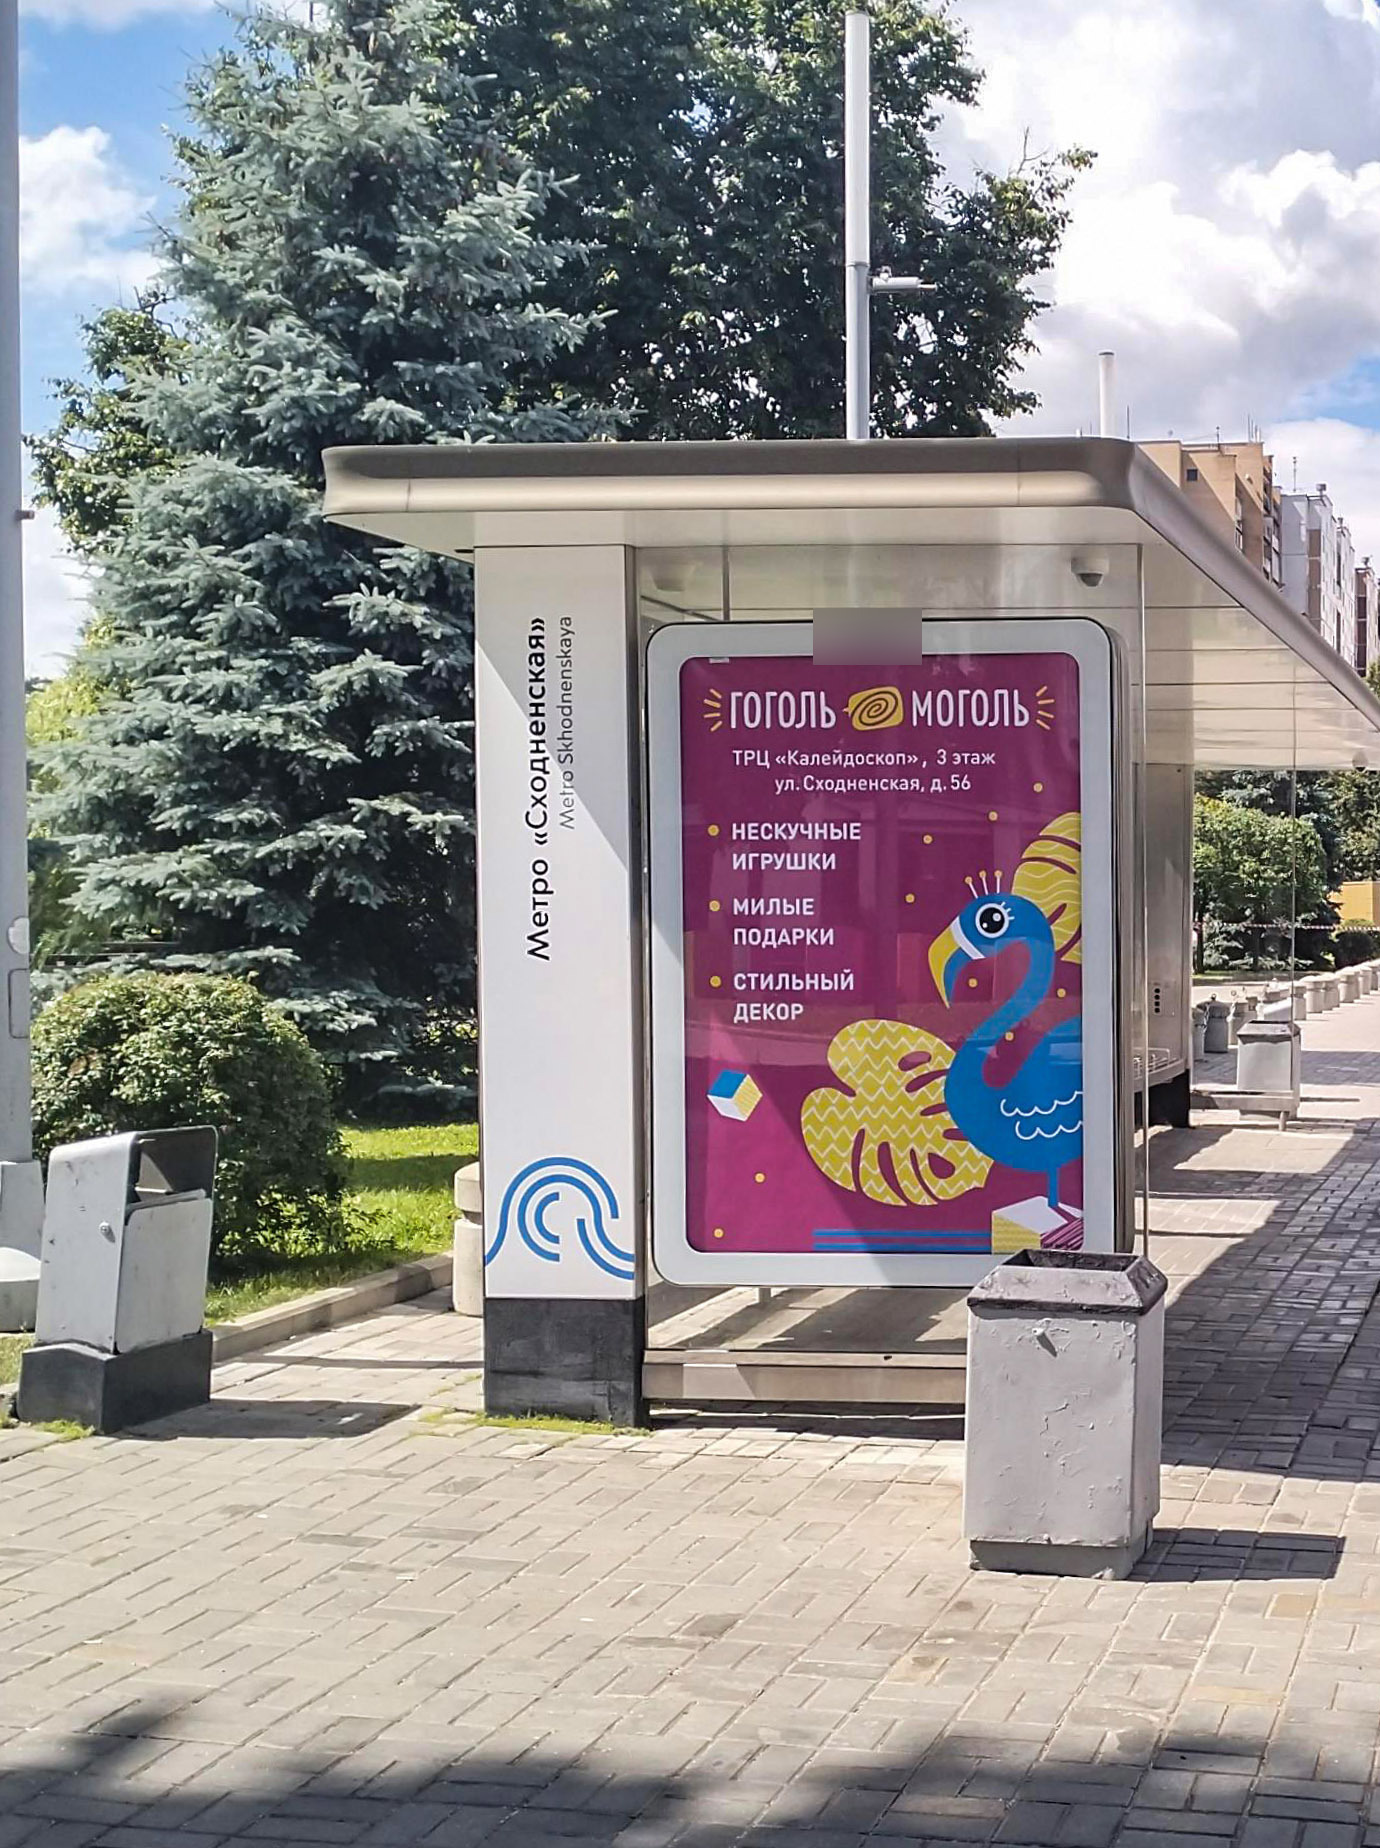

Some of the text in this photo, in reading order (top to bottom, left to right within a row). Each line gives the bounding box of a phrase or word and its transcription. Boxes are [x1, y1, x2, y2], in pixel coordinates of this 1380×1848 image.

[730, 688, 1031, 729] ГОГОЛЬ МОГОЛЬ
[554, 615, 577, 831] Metro Skhodnenskaya
[732, 749, 770, 769] ТРЦ
[936, 748, 947, 765] 3
[951, 752, 996, 766] этаж
[525, 617, 554, 962] Метро «Сходненская»
[731, 822, 862, 841] НЕСКУЧНЫЕ
[732, 852, 837, 871] ИГРУШКИ
[733, 897, 815, 917] МИЛЫЕ
[733, 927, 835, 949] ПОДАРКИ
[733, 968, 855, 992] СТИЛЬНЫЙ
[733, 1003, 804, 1024] ДЕКОР
